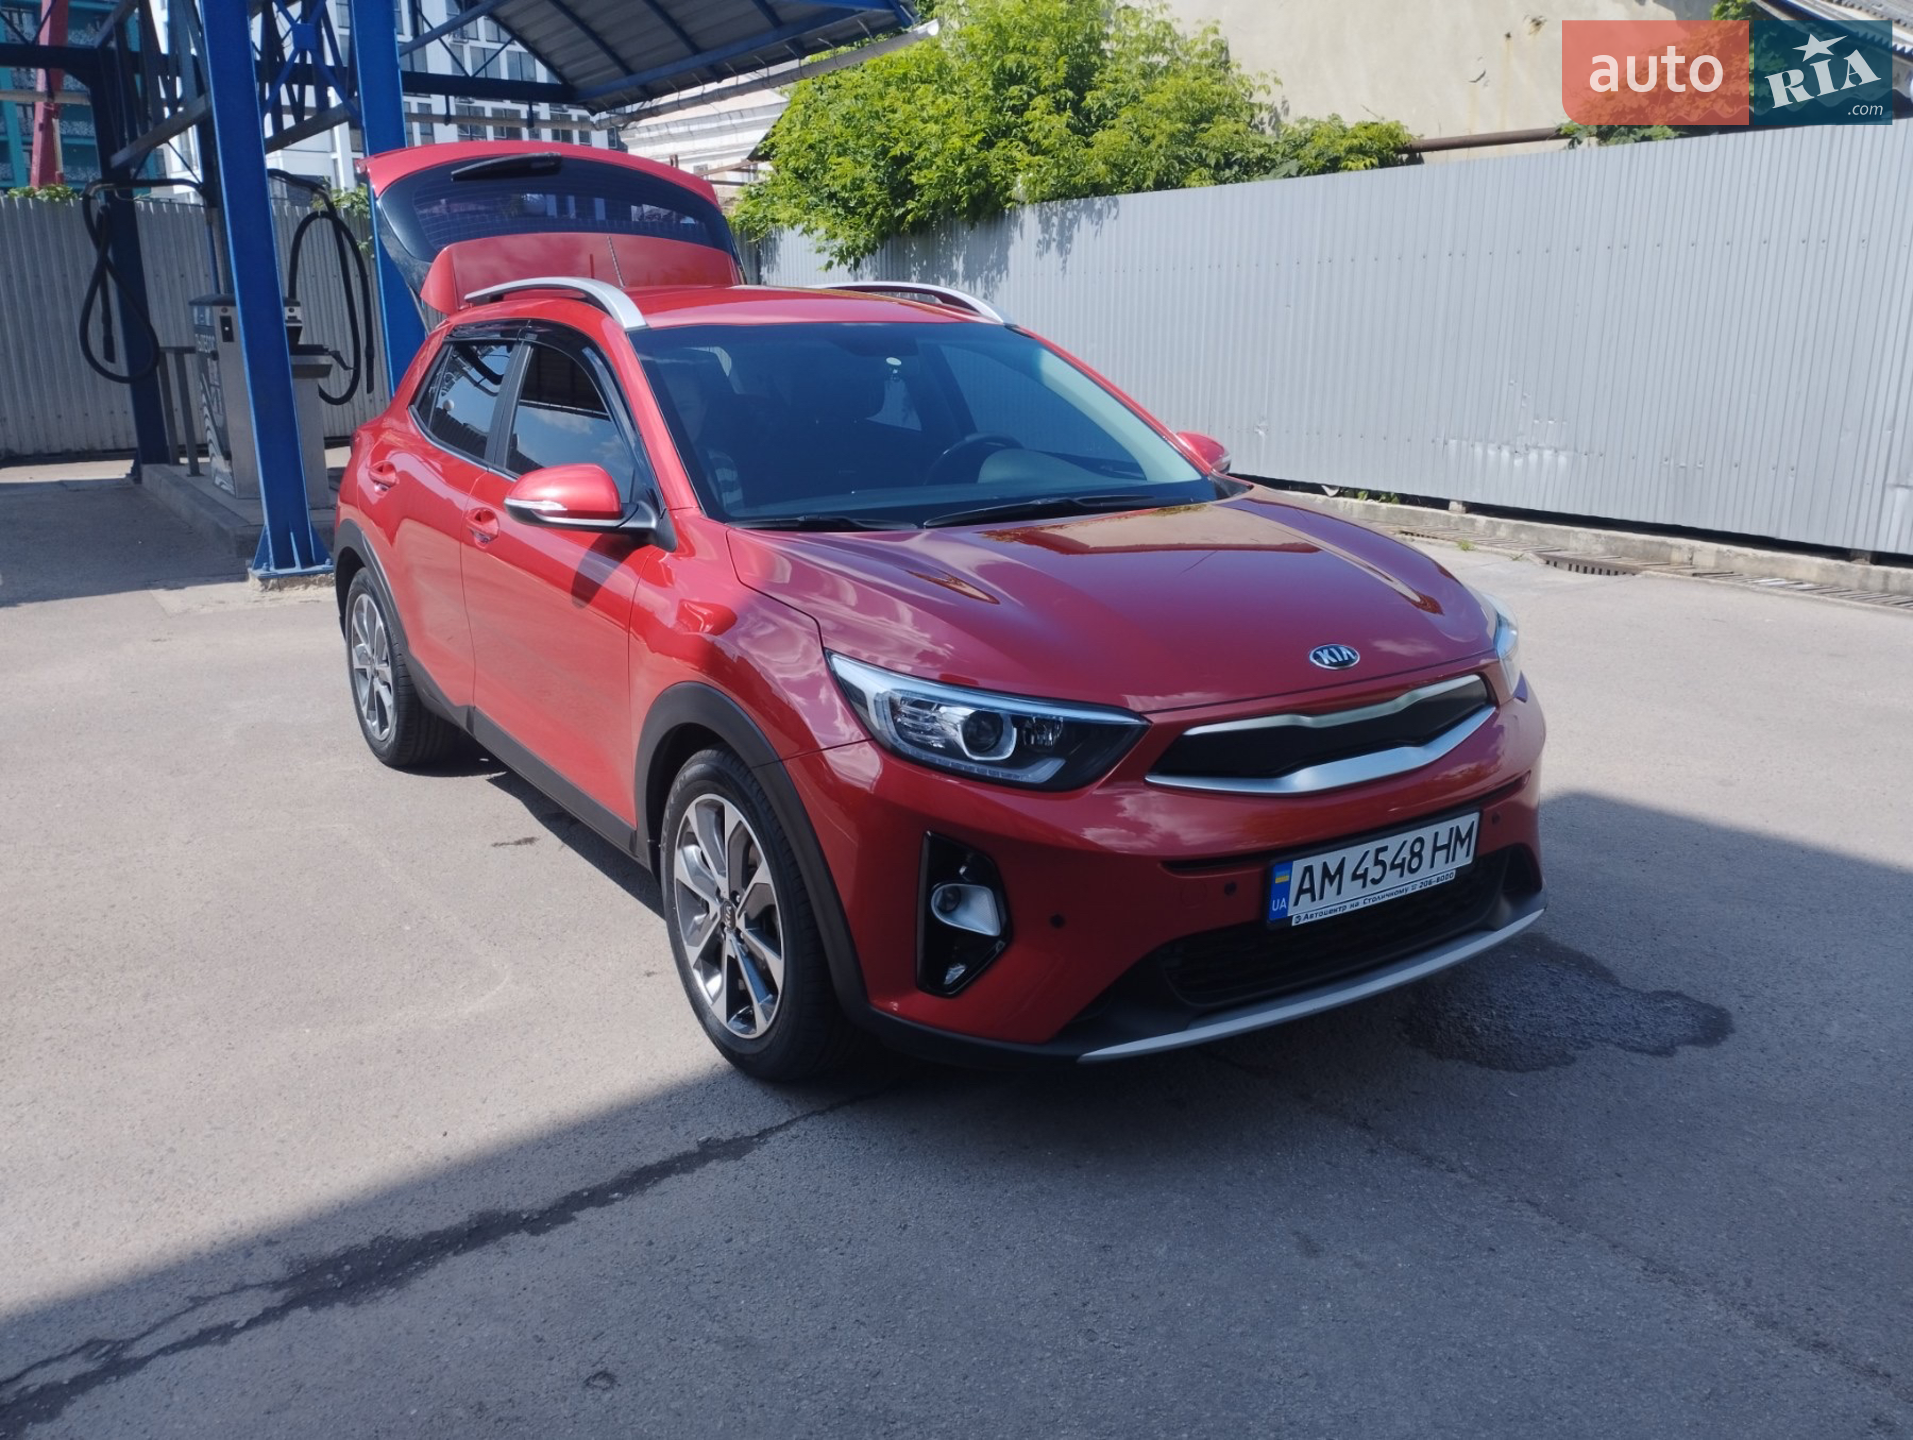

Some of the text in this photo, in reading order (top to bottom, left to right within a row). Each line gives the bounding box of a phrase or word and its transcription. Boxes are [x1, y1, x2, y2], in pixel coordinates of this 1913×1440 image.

[1316, 646, 1357, 665] KIA
[1293, 820, 1475, 907] AM 4548 HM
[1271, 897, 1287, 911] UA
[1302, 904, 1347, 922] Автоцентр
[1350, 900, 1360, 910] на
[1362, 886, 1409, 905] Столичному
